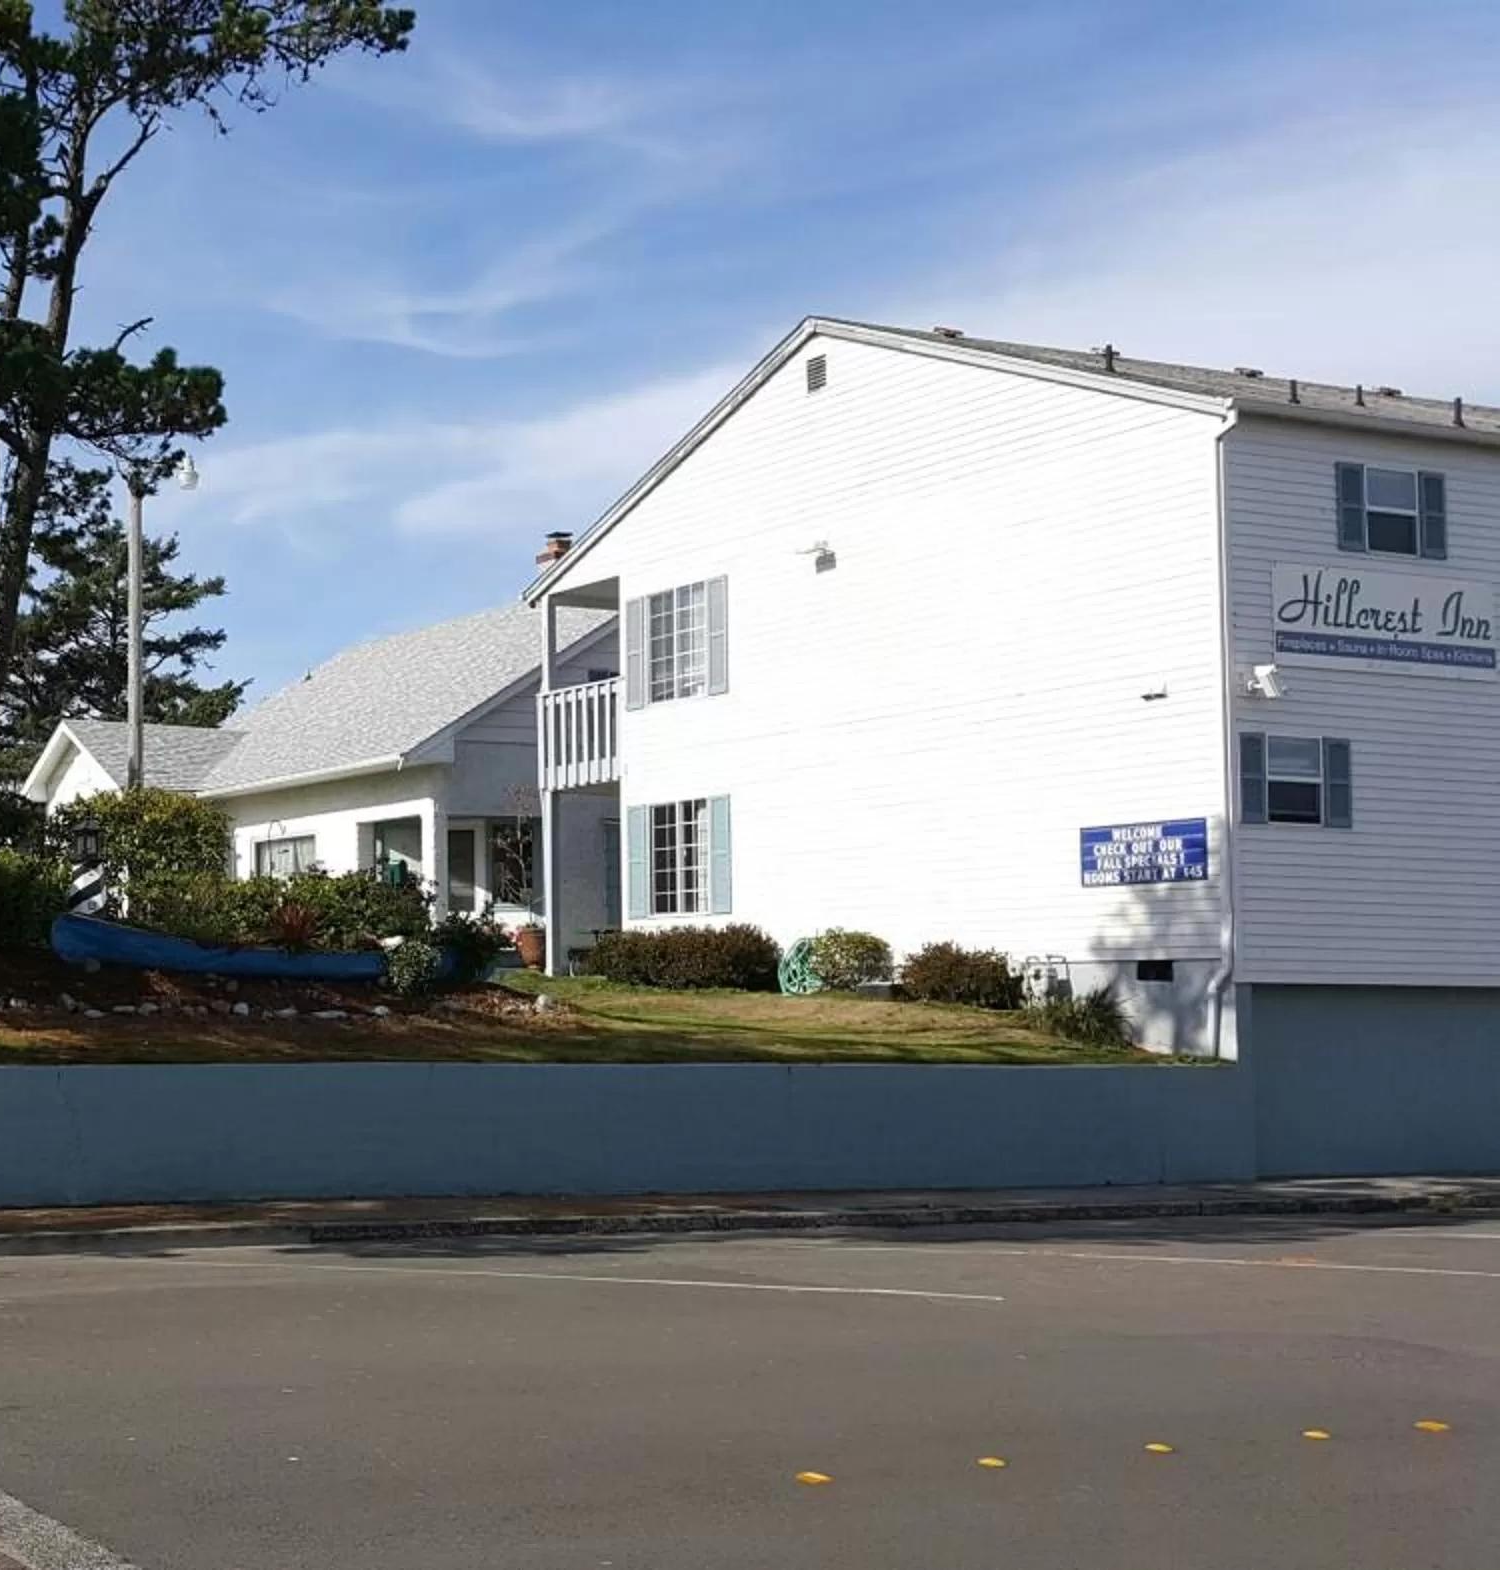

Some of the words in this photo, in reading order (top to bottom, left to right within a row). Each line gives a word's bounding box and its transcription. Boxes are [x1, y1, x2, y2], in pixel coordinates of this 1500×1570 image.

[1277, 570, 1423, 634] Hillcrest
[1436, 590, 1492, 640] Inn
[1112, 825, 1163, 842] WELCOME
[1093, 841, 1127, 857] CHECK
[1131, 840, 1154, 854] OUT
[1159, 837, 1183, 852] OUR
[1083, 869, 1121, 885] ROOMS
[1123, 866, 1160, 883] START
[1161, 865, 1177, 880] AT
